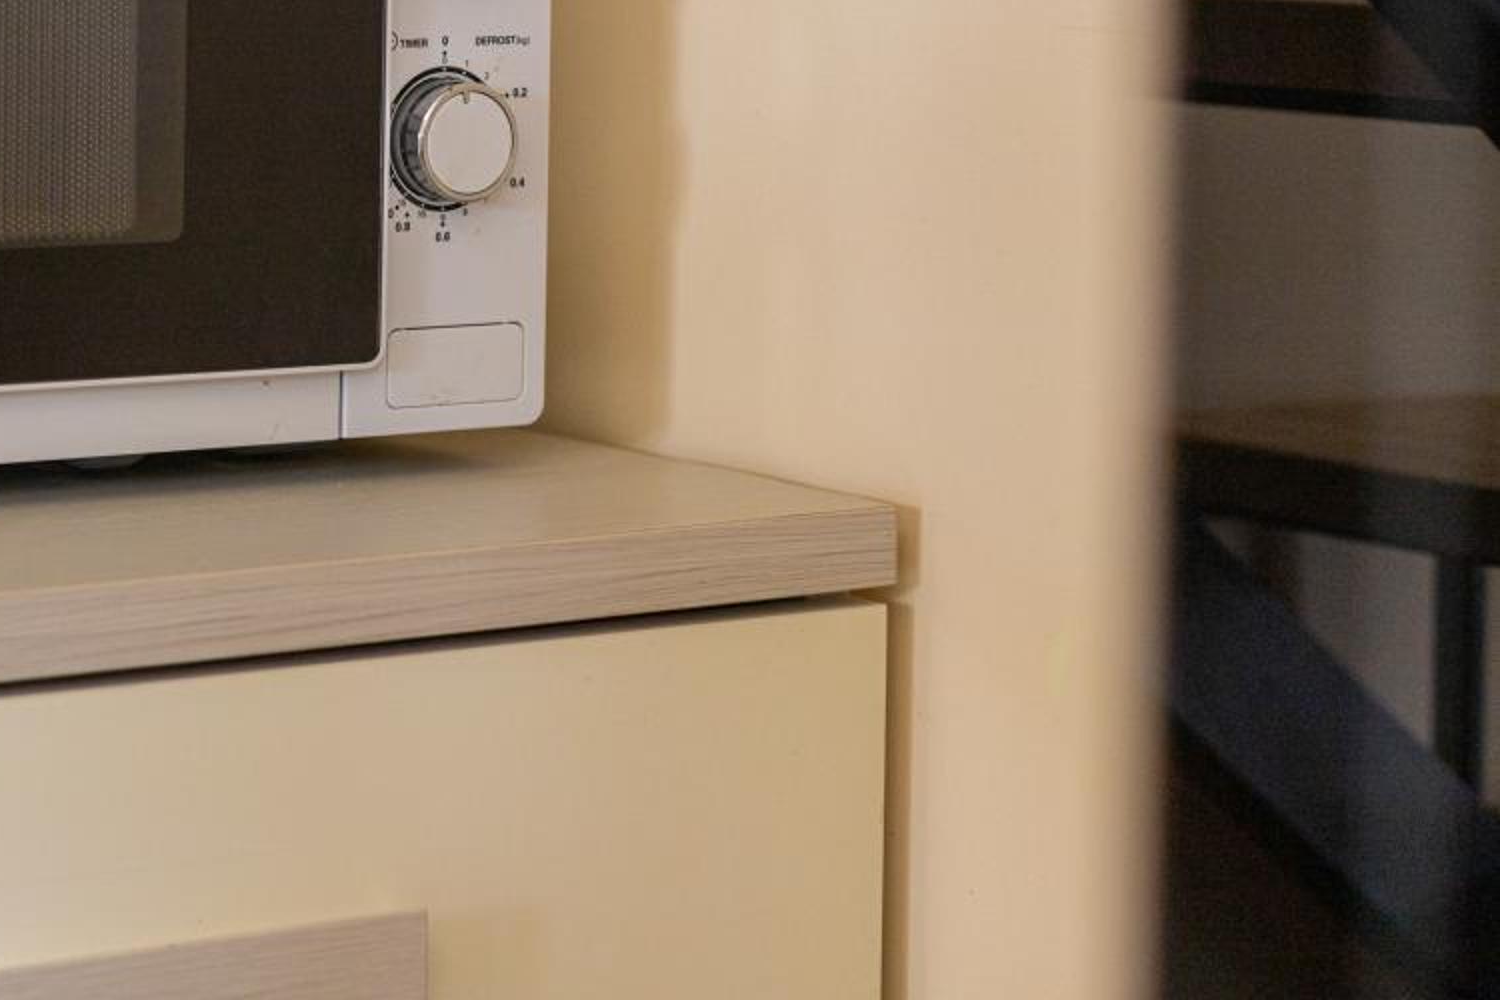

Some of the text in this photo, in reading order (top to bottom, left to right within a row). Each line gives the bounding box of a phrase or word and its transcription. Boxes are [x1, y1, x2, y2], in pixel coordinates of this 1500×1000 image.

[400, 38, 429, 48] TIMER
[512, 87, 528, 98] 0.2
[510, 177, 525, 188] 0.4
